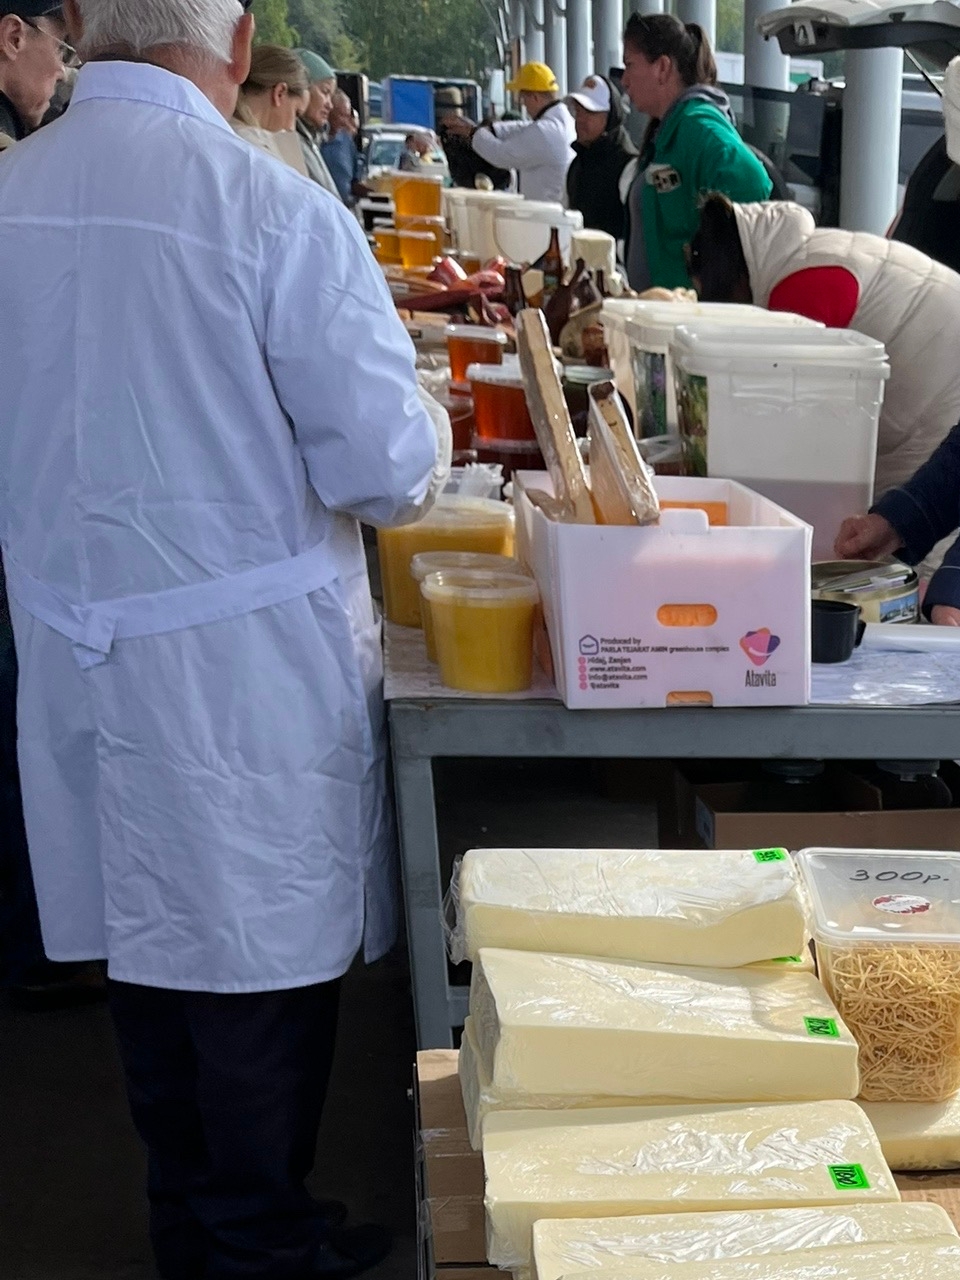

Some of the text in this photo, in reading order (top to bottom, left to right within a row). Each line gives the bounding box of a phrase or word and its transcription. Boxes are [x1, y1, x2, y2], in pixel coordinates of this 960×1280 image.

[600, 637, 642, 646] Produced by
[745, 669, 777, 687] Atavita
